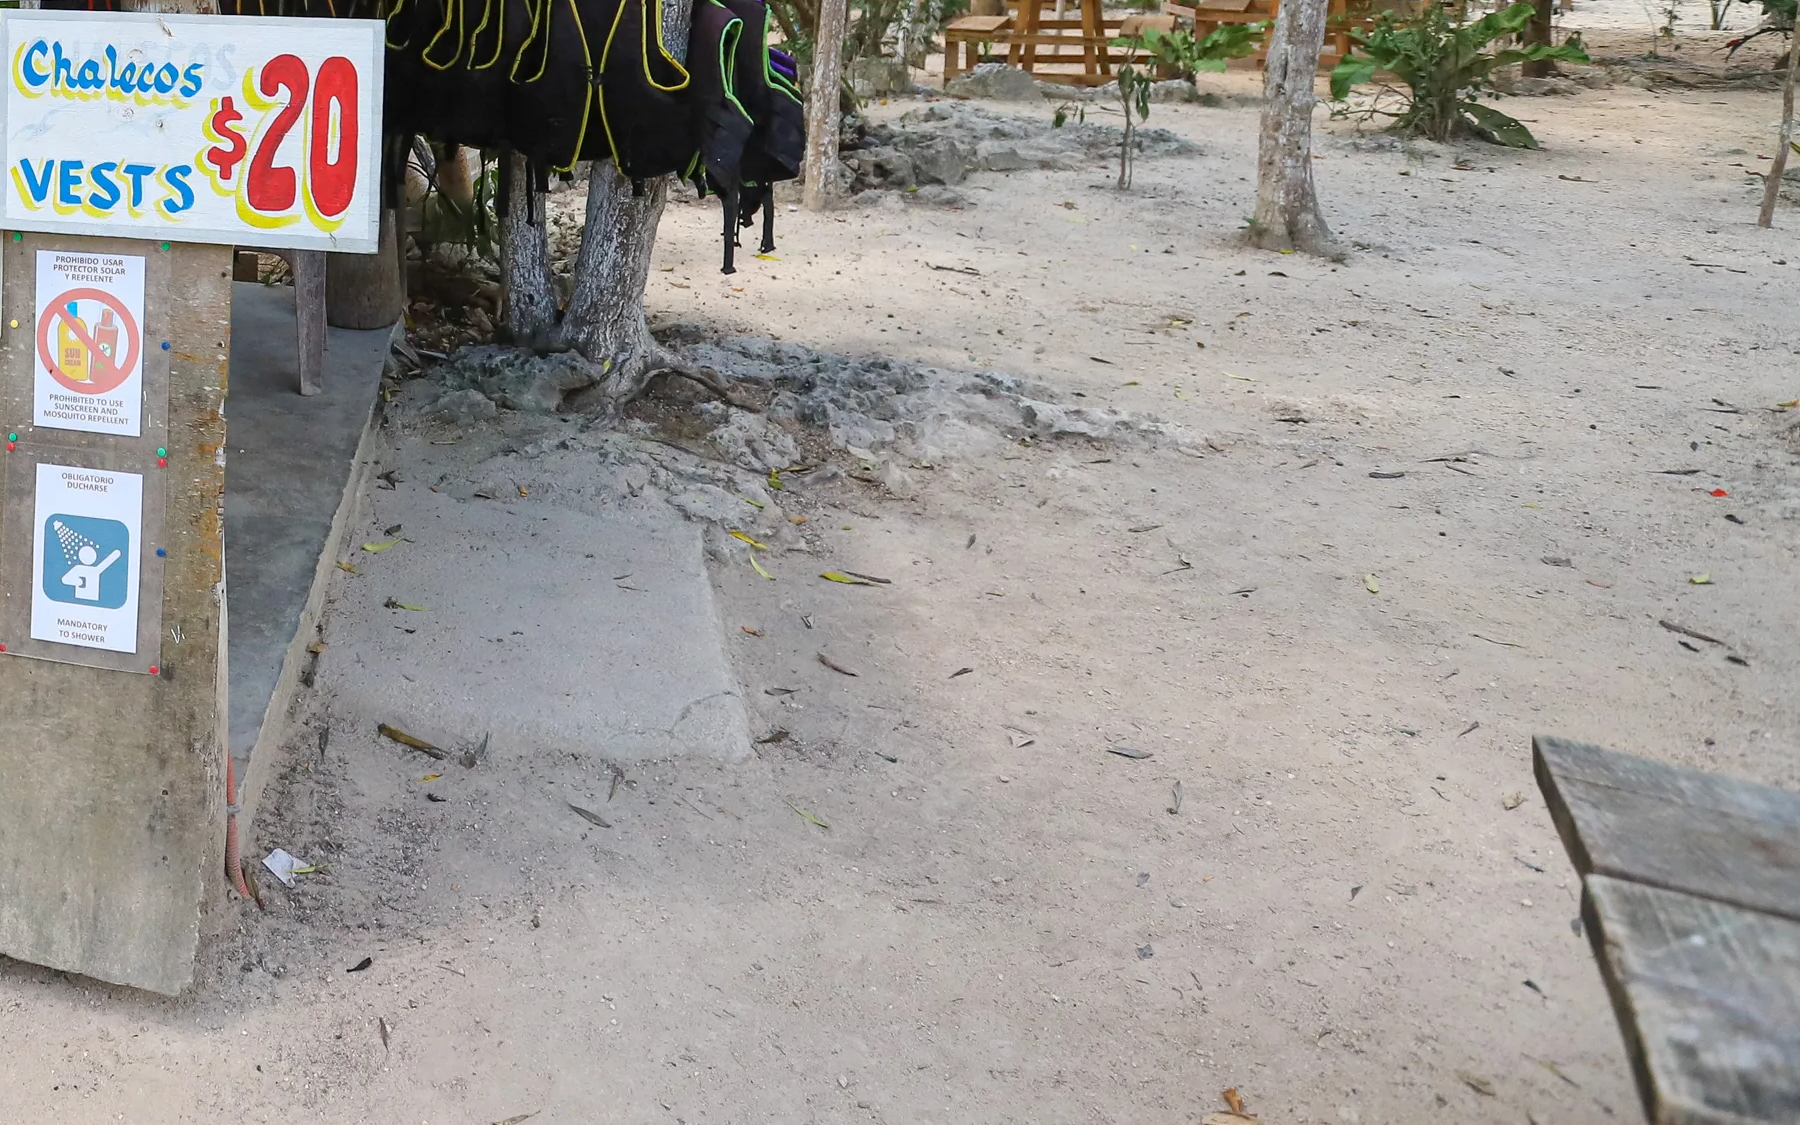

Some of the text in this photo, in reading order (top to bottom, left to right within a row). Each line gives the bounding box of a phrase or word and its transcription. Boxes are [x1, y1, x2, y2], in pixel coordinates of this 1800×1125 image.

[22, 40, 203, 98] Chalecos
[207, 54, 358, 217] $20
[20, 158, 195, 213] VESTS
[56, 255, 123, 266] PROHIBIDO USAR
[53, 264, 126, 275] PROTECTOR SOLAR
[71, 274, 113, 283] REPELENTE
[49, 394, 93, 406] PROHIBITED
[55, 402, 118, 415] SUNSCREEN AND
[43, 410, 129, 425] MOSQUITO REPELLENT
[61, 473, 113, 484] OBLIGATORIO
[67, 482, 108, 492] DUCHARSE
[57, 618, 108, 631] MANDATORY
[72, 631, 105, 643] SHOWER
